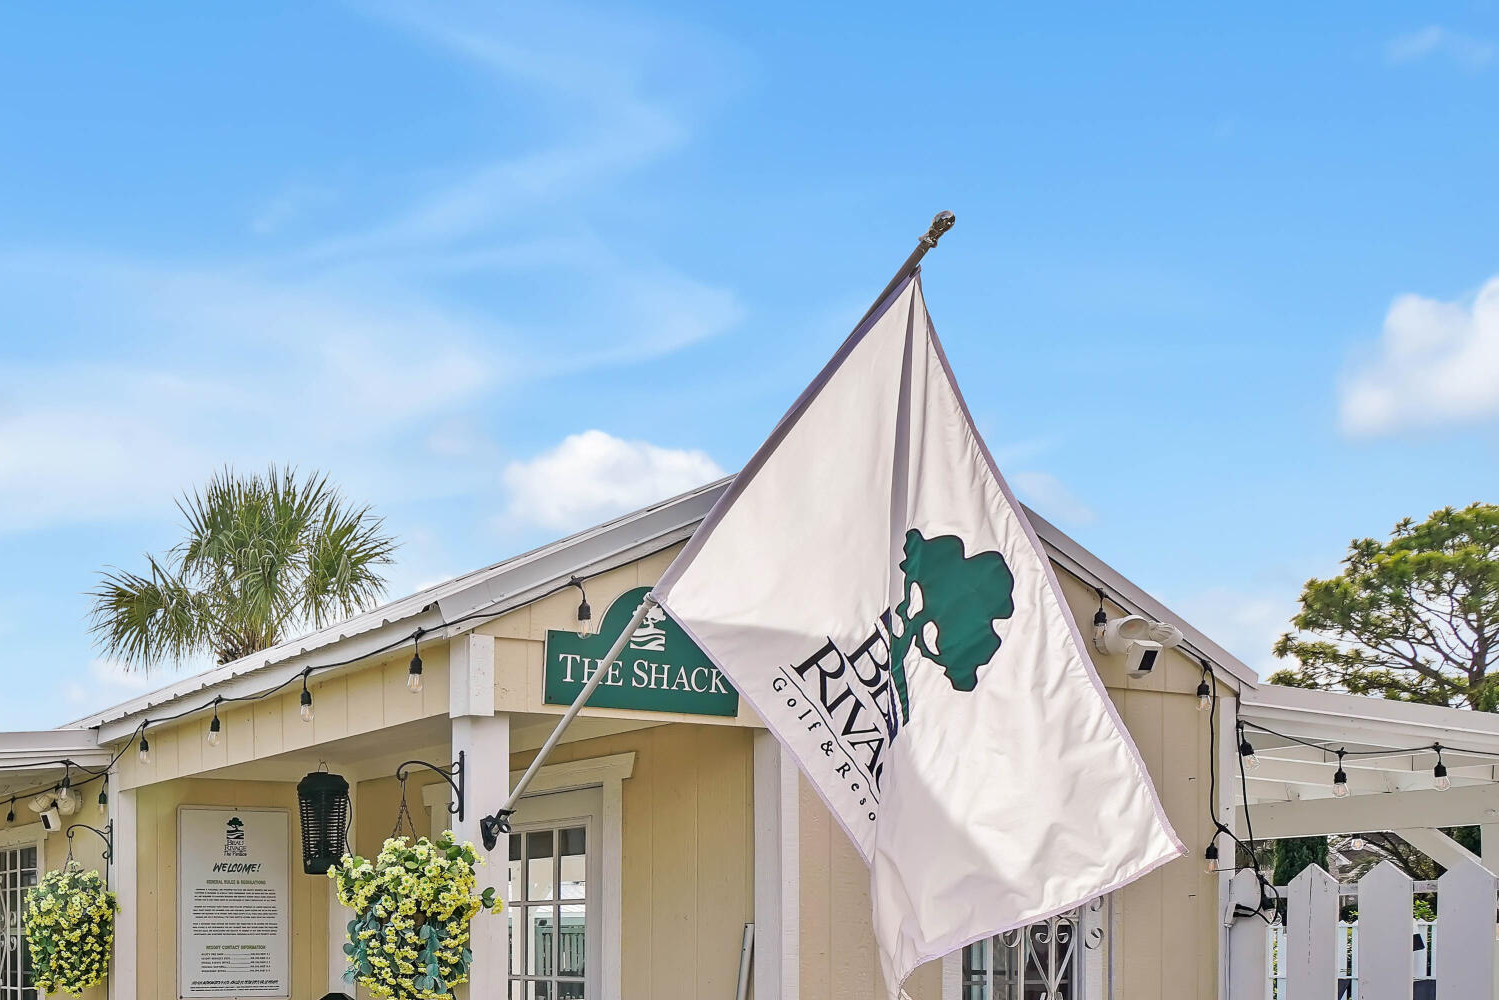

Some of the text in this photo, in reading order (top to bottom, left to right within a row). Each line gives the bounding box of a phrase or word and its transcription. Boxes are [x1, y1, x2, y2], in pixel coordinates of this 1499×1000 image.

[558, 653, 728, 694] THE SHACK
[791, 636, 884, 793] RIVA
[772, 677, 876, 821] Golf & Reso
[212, 862, 261, 874] WELCOME!
